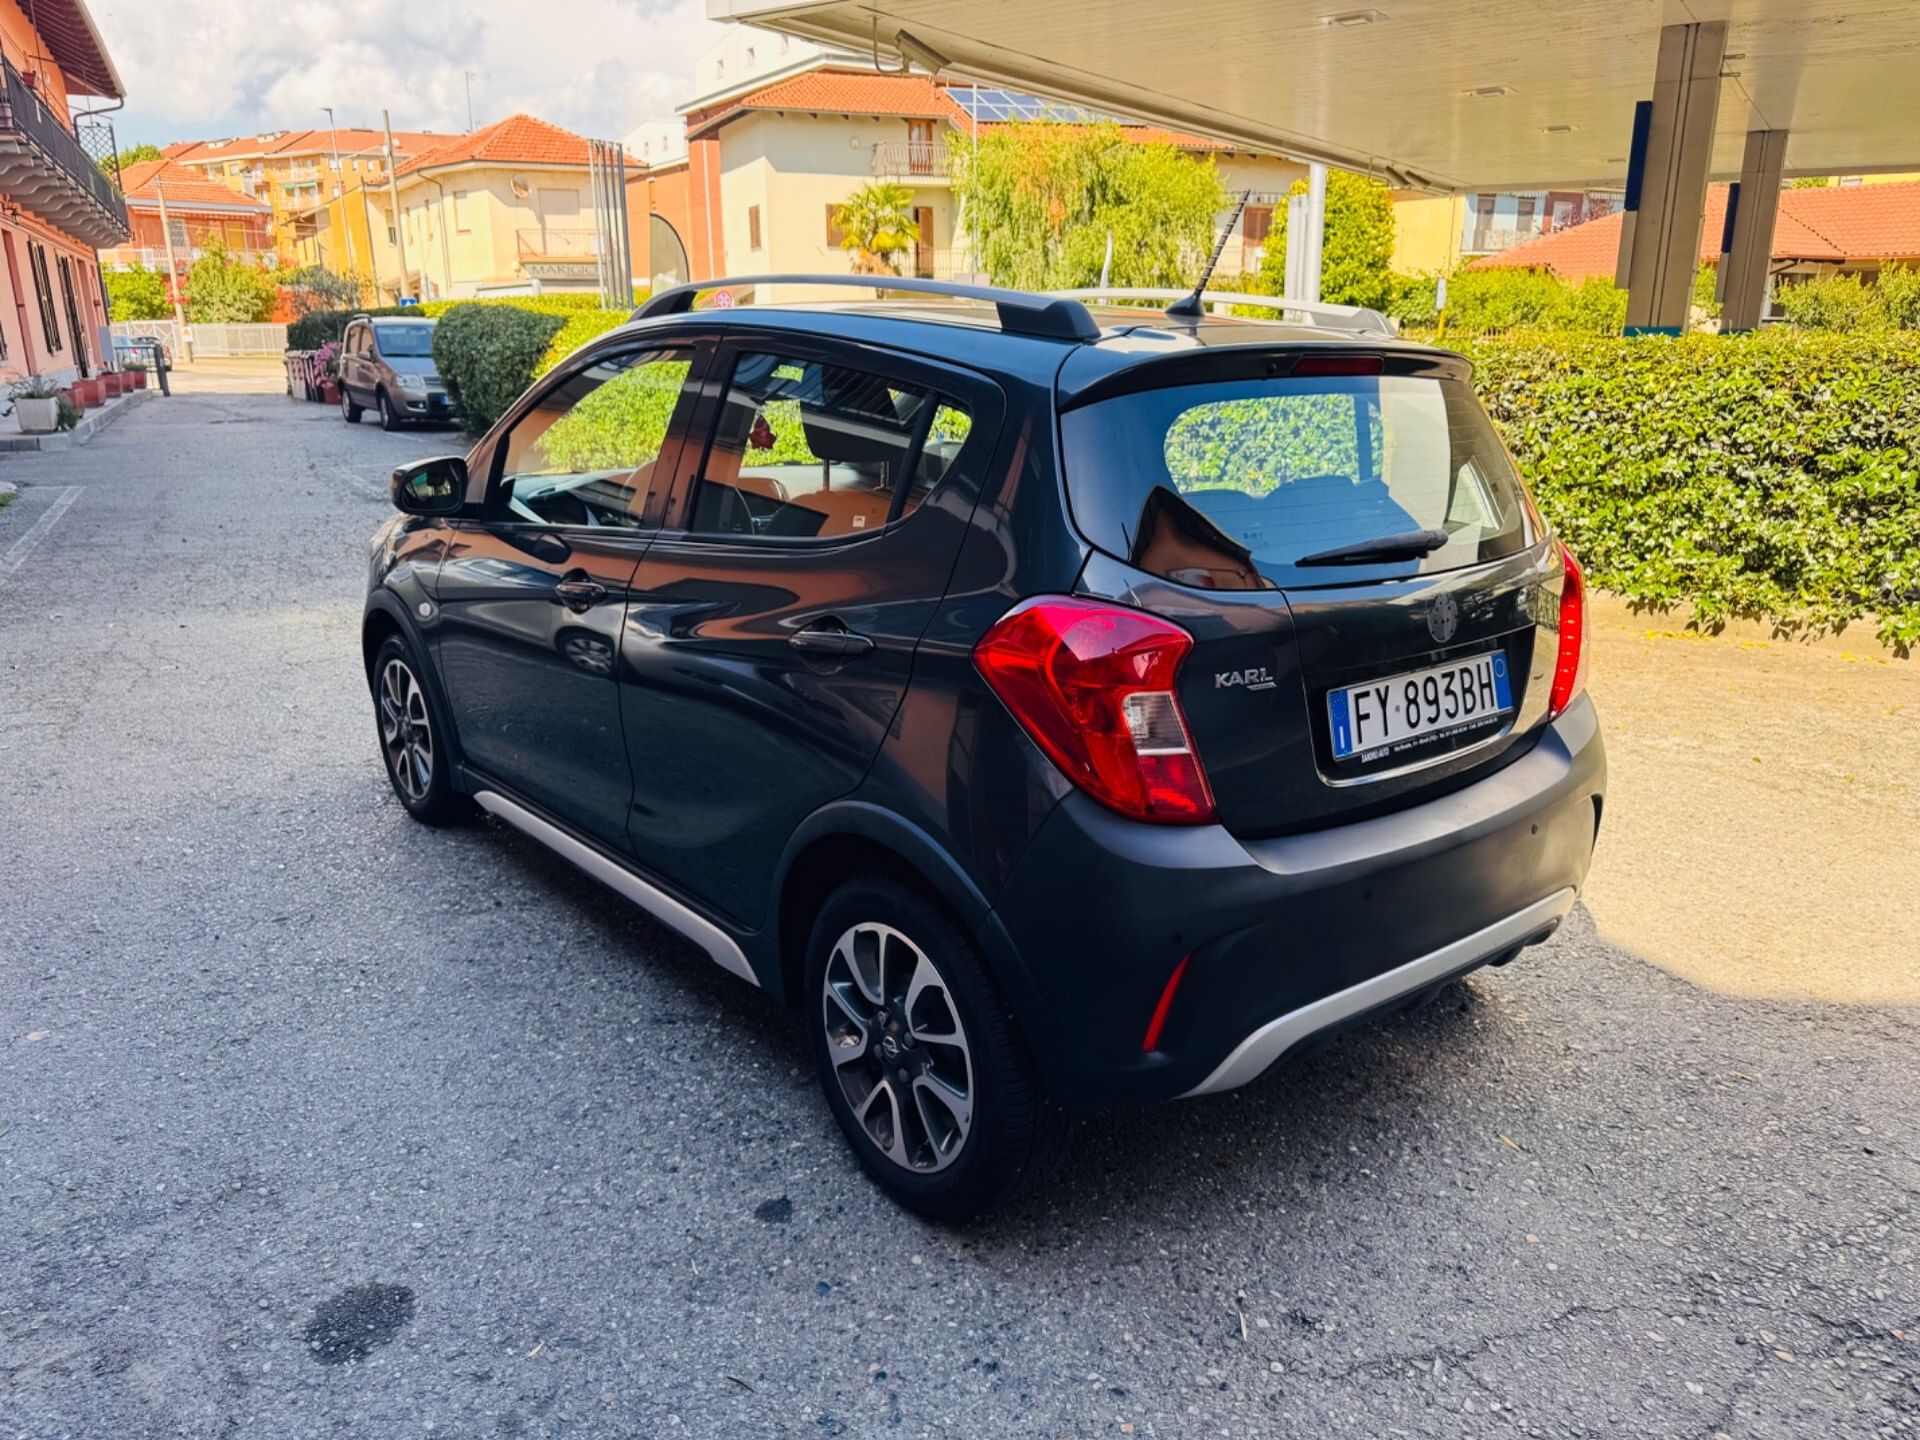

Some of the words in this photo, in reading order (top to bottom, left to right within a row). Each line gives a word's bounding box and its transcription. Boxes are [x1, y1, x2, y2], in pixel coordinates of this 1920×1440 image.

[1214, 667, 1273, 688] KARL
[1354, 685, 1390, 744] FY
[1404, 662, 1495, 729] 893BH
